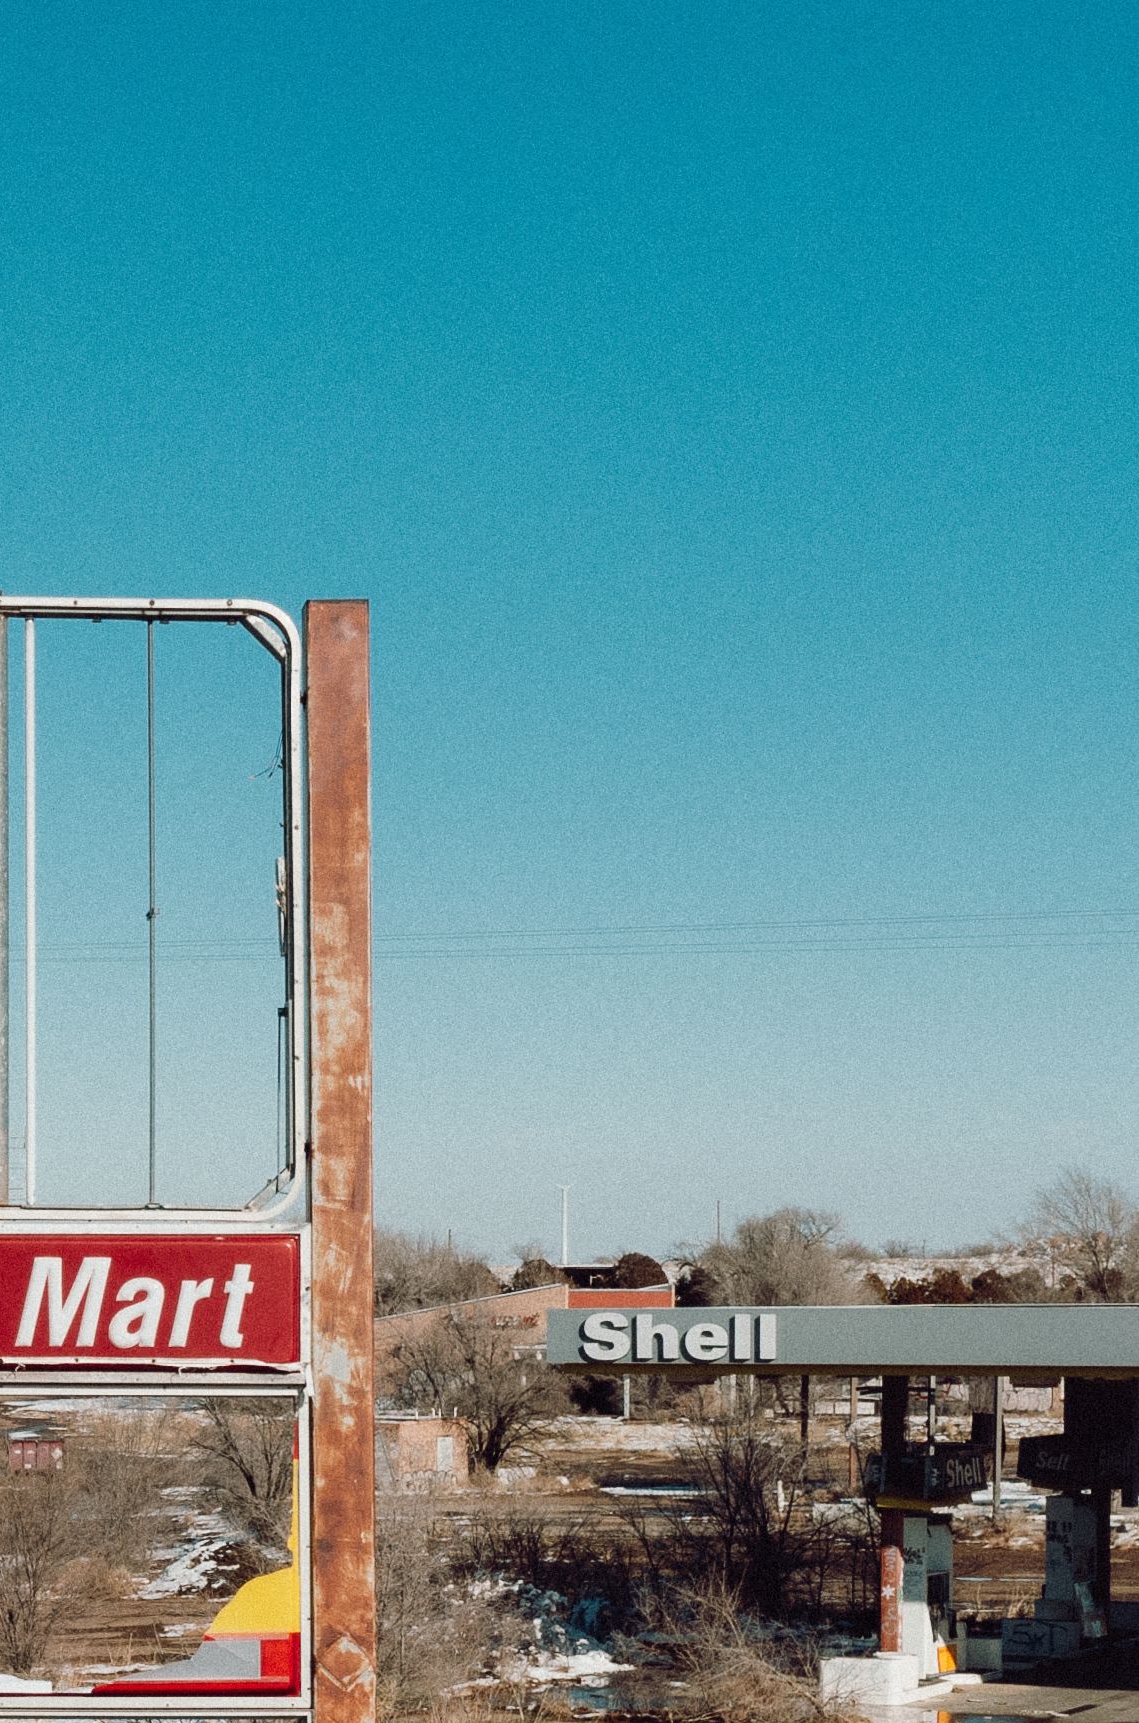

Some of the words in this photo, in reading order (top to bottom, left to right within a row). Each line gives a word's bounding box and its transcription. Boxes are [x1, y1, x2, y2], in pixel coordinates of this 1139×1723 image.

[15, 1256, 254, 1349] Mart
[578, 1312, 777, 1362] Shell
[946, 1457, 982, 1488] Shell
